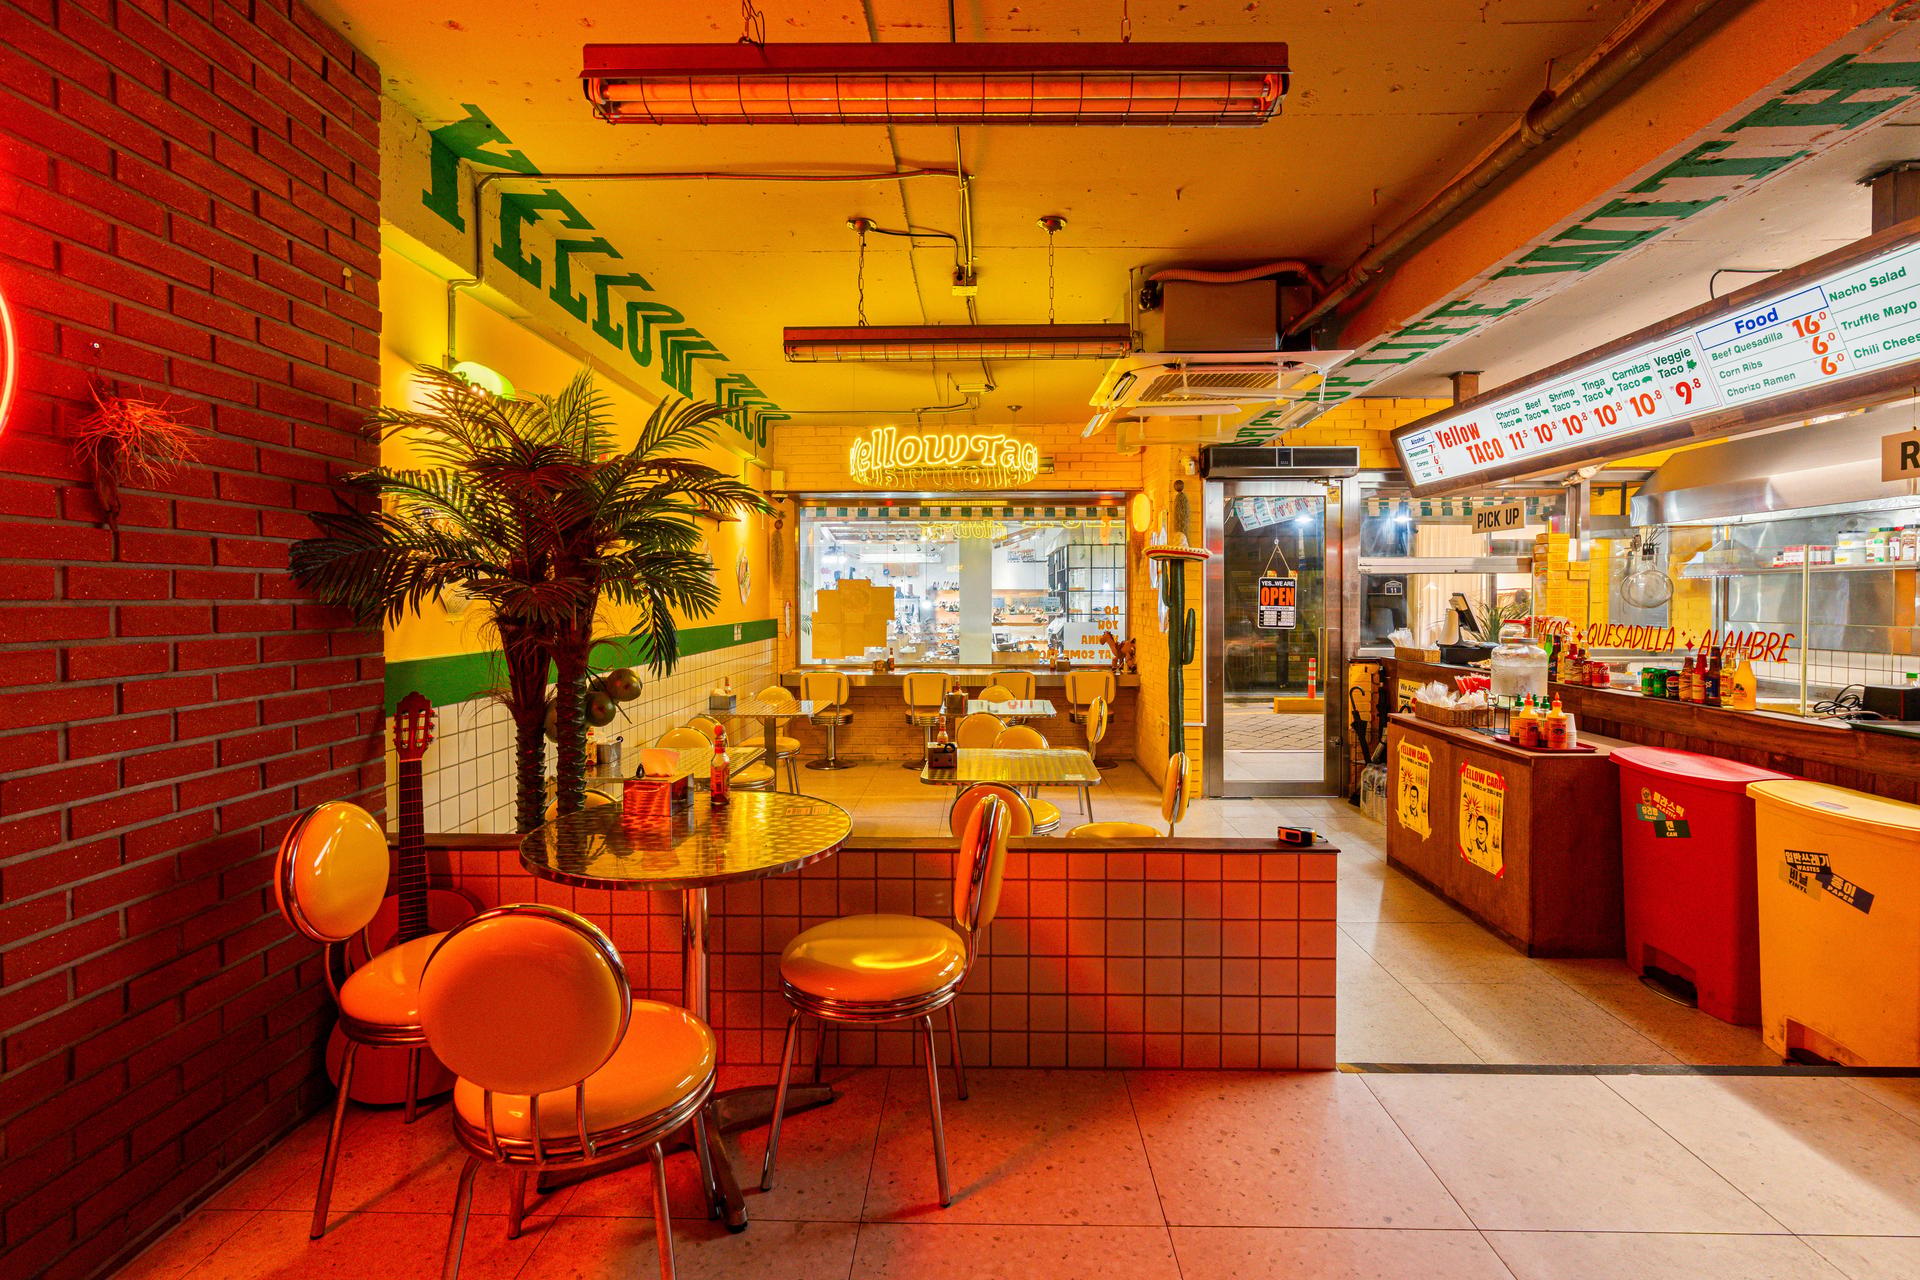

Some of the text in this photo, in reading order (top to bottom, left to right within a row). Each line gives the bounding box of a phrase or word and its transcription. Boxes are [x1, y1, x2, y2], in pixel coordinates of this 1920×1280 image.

[1344, 297, 1533, 367] LIFE
[1487, 53, 1920, 282] WITH
[422, 103, 793, 448] YELLOW TACO
[1829, 266, 1907, 302] Nacho Salad
[1734, 307, 1780, 334] Food
[1840, 300, 1918, 331] Truffle Mayo
[1711, 331, 1783, 361] Beef Quesadilla
[1853, 343, 1880, 359] Chili
[1653, 347, 1692, 367] Veggie
[1612, 362, 1651, 381] Carnitas
[1657, 364, 1684, 380] Taco
[1719, 359, 1764, 379] Corn Ribs
[1582, 377, 1606, 392] Tinga
[1616, 379, 1641, 392] Taco
[1726, 371, 1796, 398] Chorizo Ramen
[1524, 397, 1542, 410] Beef
[1548, 388, 1576, 403] Shrimp
[1582, 391, 1604, 404] Taco
[1496, 406, 1520, 421] Chorizo
[1524, 410, 1542, 422] Taco
[1552, 401, 1572, 413] Taco
[1499, 418, 1516, 430] Taco
[1435, 422, 1481, 450] Yellow
[1466, 437, 1505, 464] TACO
[1477, 507, 1520, 529] PICK UP
[1261, 586, 1294, 606] OPEN
[1587, 623, 1675, 653] QUESADILLA
[1653, 792, 1684, 817] 플라스틱
[1656, 804, 1676, 819] PLASTIC
[1665, 821, 1675, 831] 캔
[1785, 852, 1830, 867] 일반쓰레기
[1788, 879, 1808, 894] VINYL
[1827, 885, 1854, 904] PAPER
[1830, 875, 1856, 897] 종이
